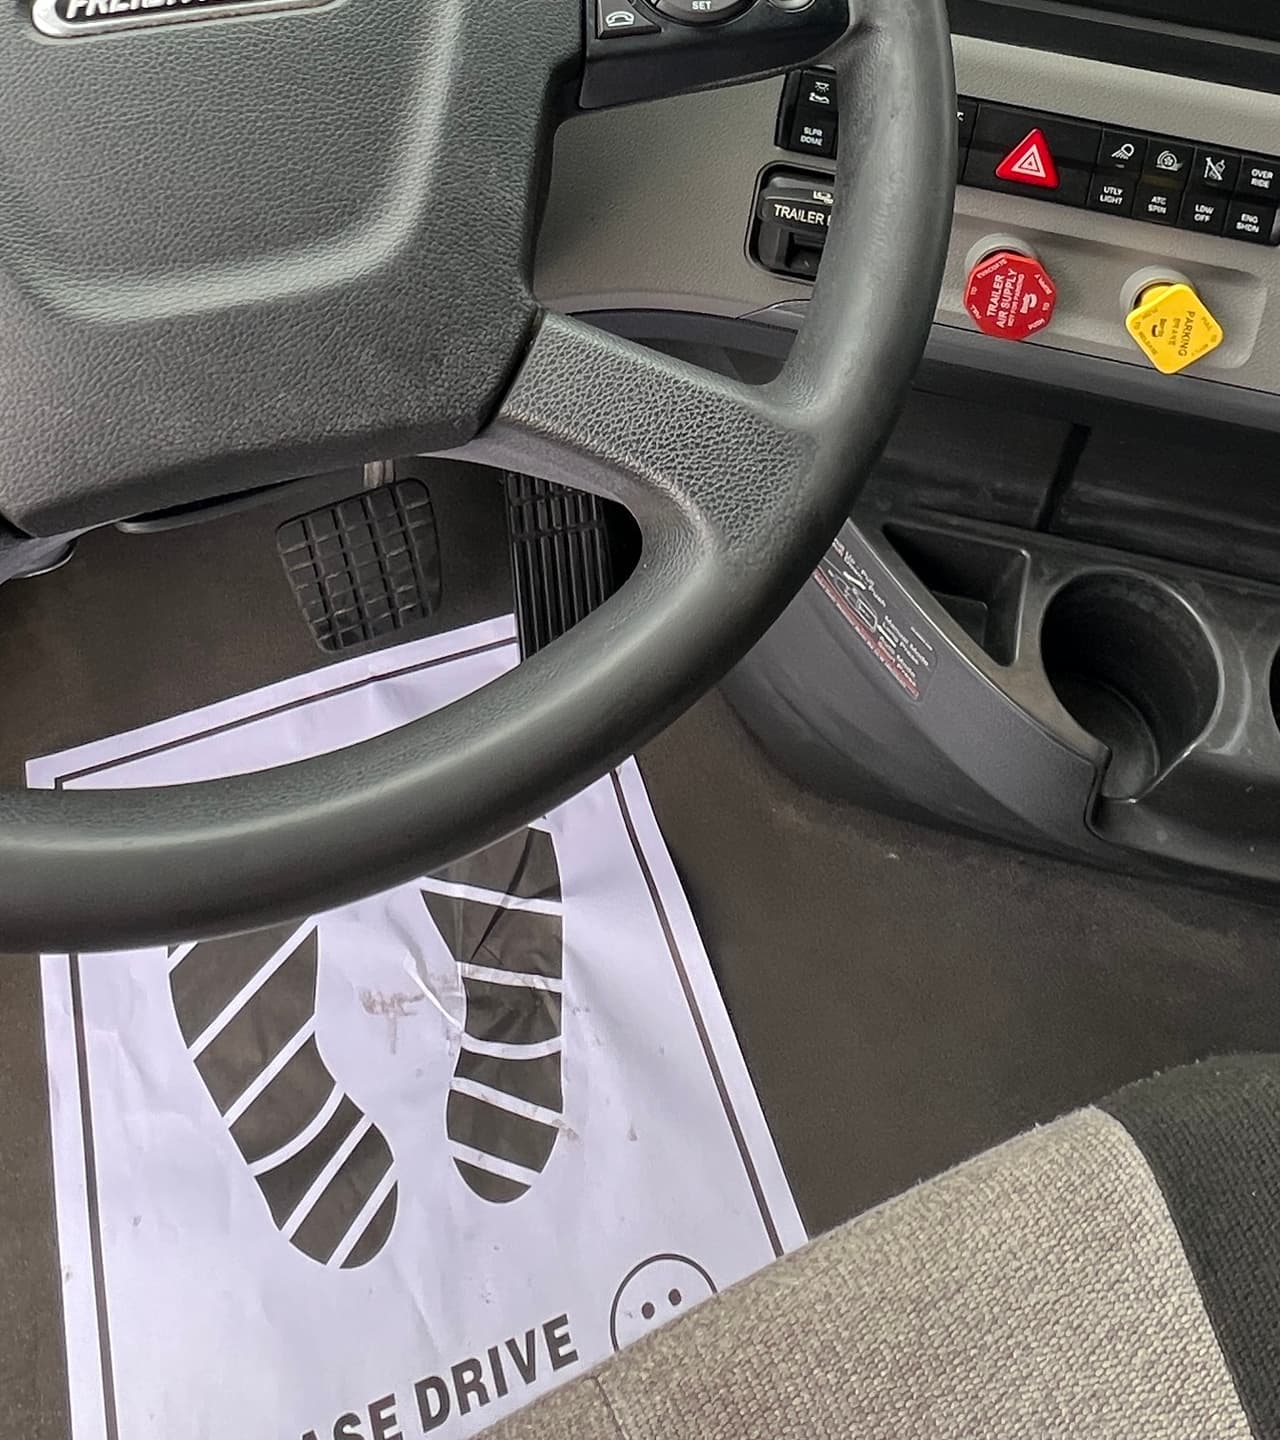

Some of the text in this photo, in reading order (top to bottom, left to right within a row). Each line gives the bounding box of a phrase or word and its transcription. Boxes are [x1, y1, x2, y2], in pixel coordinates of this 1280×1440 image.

[692, 0, 712, 10] SET
[1251, 168, 1274, 180] OVER
[1099, 194, 1123, 205] LIGHT
[773, 204, 824, 226] TRAILER
[1194, 213, 1211, 223] OFF
[986, 274, 1005, 316] TRAILER
[996, 268, 1018, 328] AIR SUPPLY
[1177, 310, 1195, 357] PARKING
[414, 1313, 579, 1434] DRIVE
